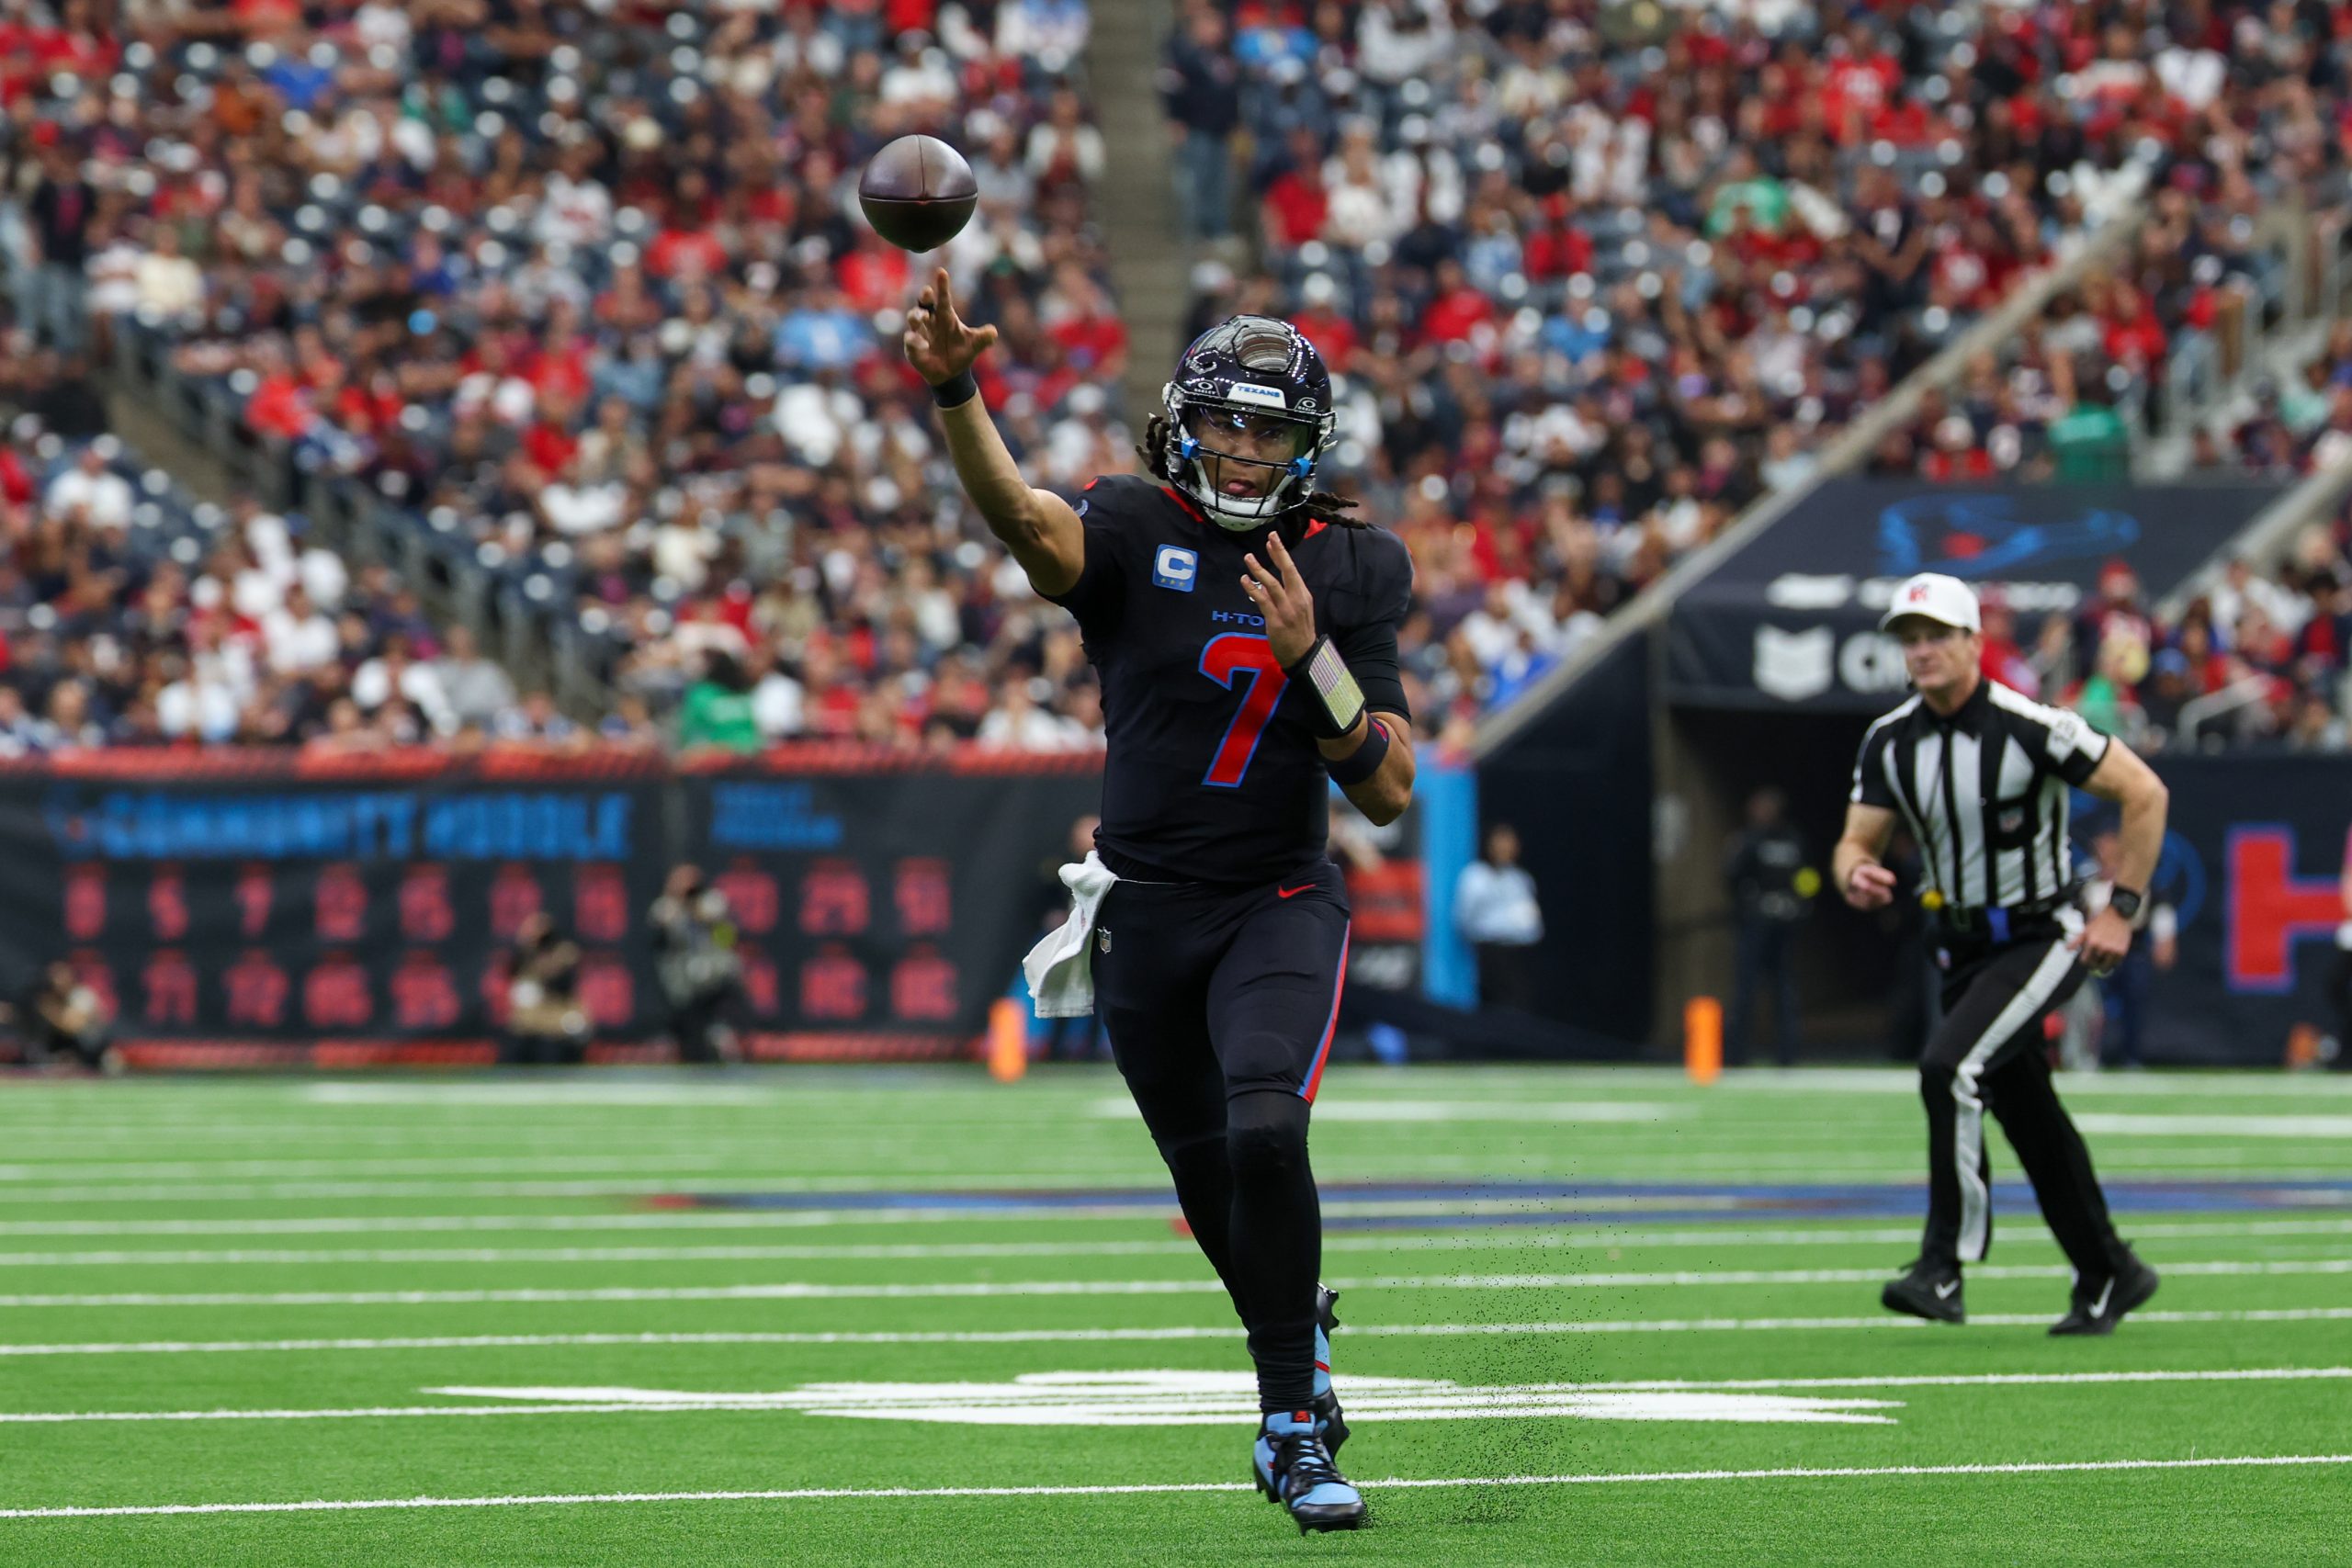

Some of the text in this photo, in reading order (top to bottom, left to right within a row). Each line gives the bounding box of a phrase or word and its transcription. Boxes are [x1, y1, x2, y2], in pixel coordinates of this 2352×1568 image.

[1237, 385, 1281, 398] TEXANS
[1157, 547, 1195, 581] C
[1212, 610, 1265, 626] H-TO
[1198, 632, 1289, 788] 7
